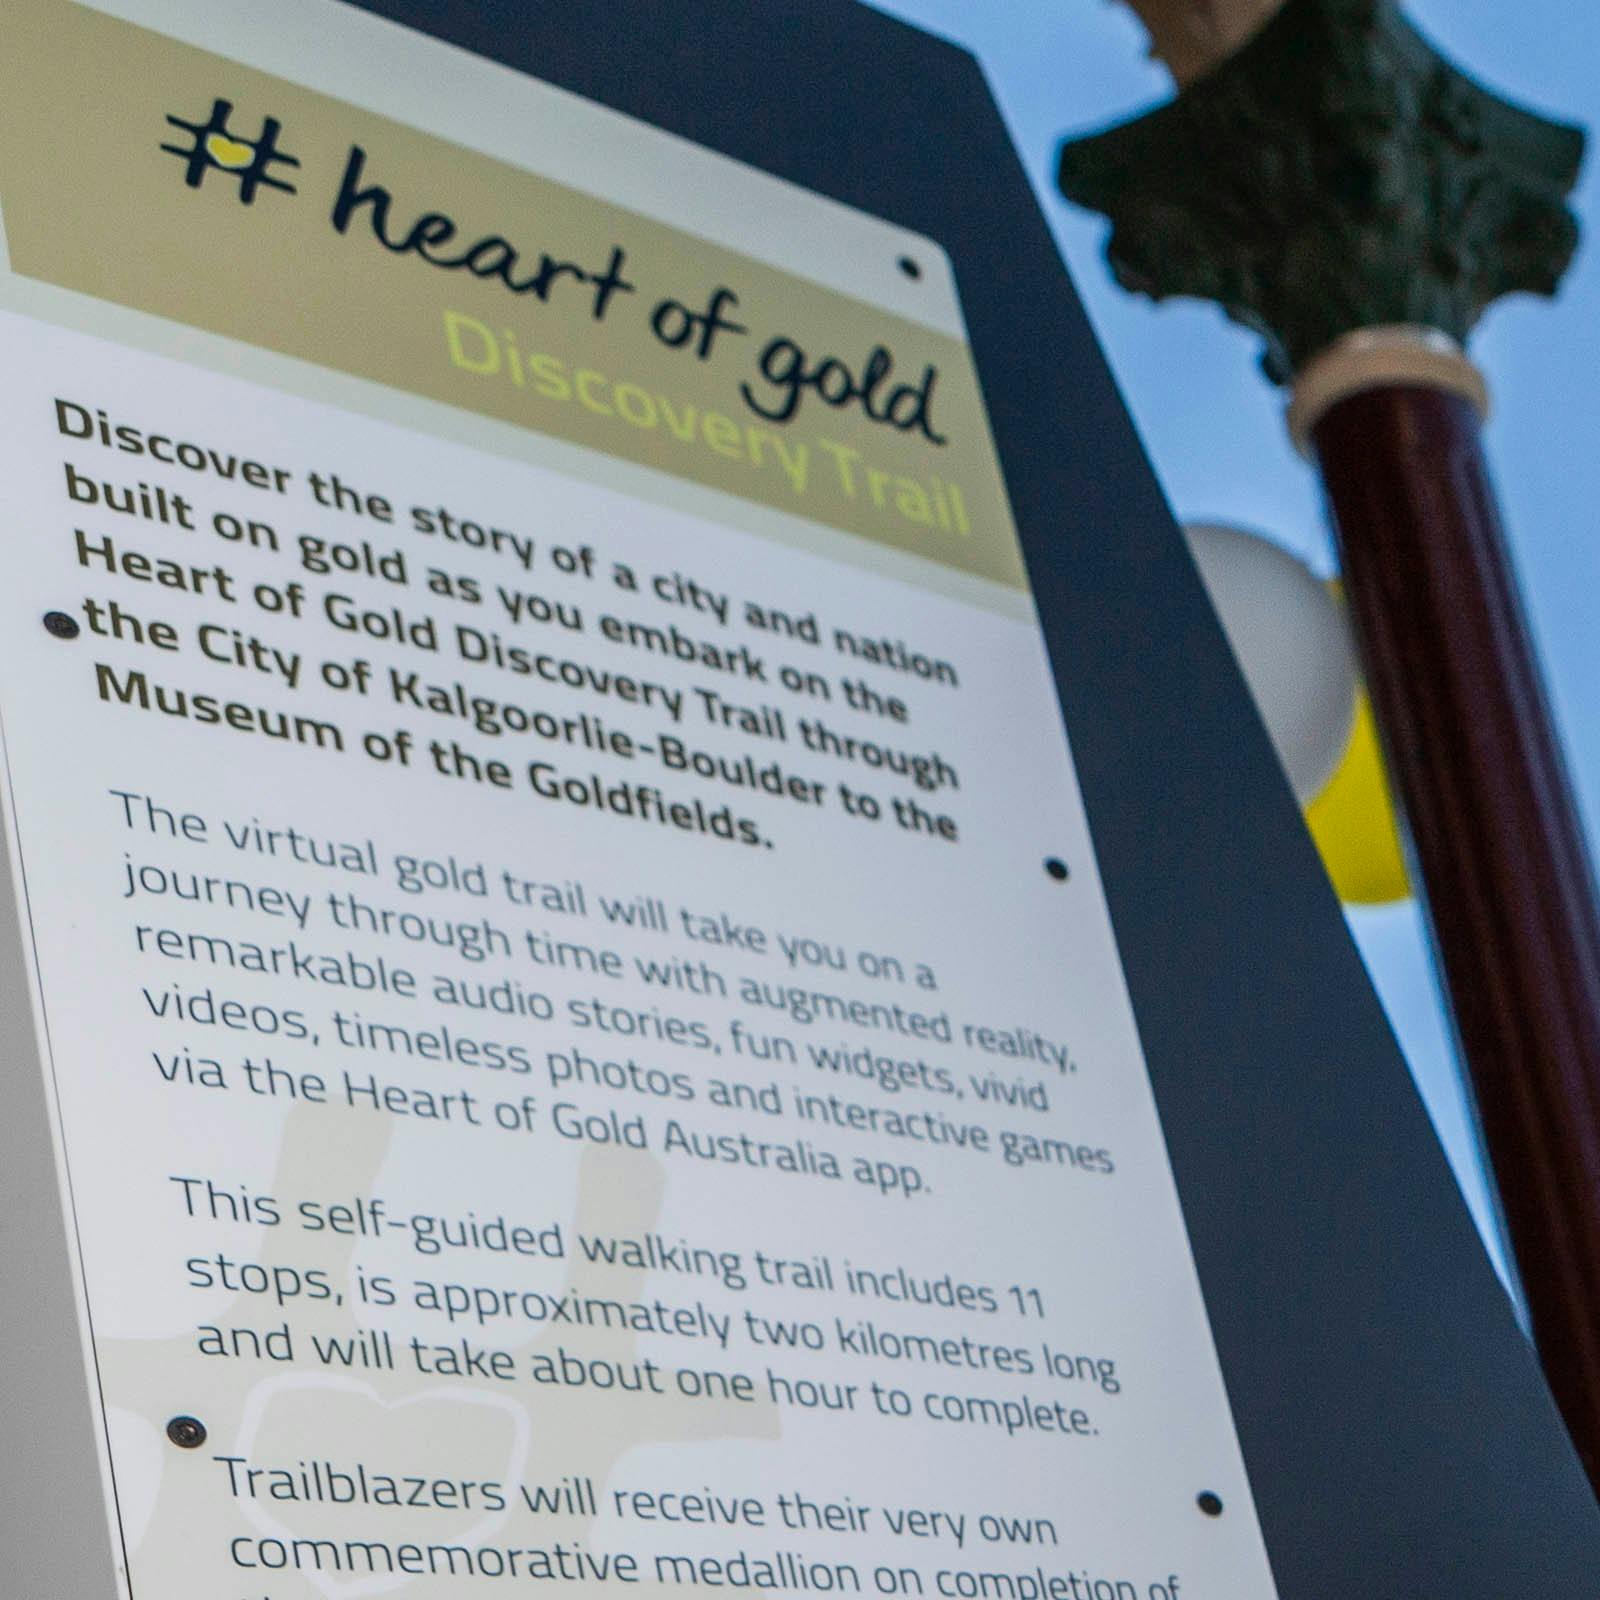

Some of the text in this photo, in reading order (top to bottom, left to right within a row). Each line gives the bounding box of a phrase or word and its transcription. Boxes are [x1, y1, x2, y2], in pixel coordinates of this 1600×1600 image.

[332, 144, 636, 321] heart
[651, 286, 745, 361] of
[740, 346, 946, 445] gold
[443, 310, 970, 537] Discovery Trail
[53, 396, 959, 687] Discover the story of a city and nation
[73, 527, 960, 792] Heart of Gold Discovery Trail through
[81, 596, 958, 843] the City of Kalgoorlie-Boulder to the
[123, 851, 1077, 1075] journey through time with augmented reality,
[134, 924, 1050, 1113] remarkable audio stories, fun widgets, vivid
[140, 982, 1116, 1175] videos, timeless photos and interactive games
[169, 1175, 1045, 1319] This self-guided walking trail includes 11
[185, 1252, 1122, 1394] stops, is approximately two kilometres long
[214, 1455, 1059, 1550] Trailblazers will receive their very own
[229, 1536, 640, 1584] commemorative
[653, 1549, 862, 1593] medallion
[873, 1566, 924, 1596] on
